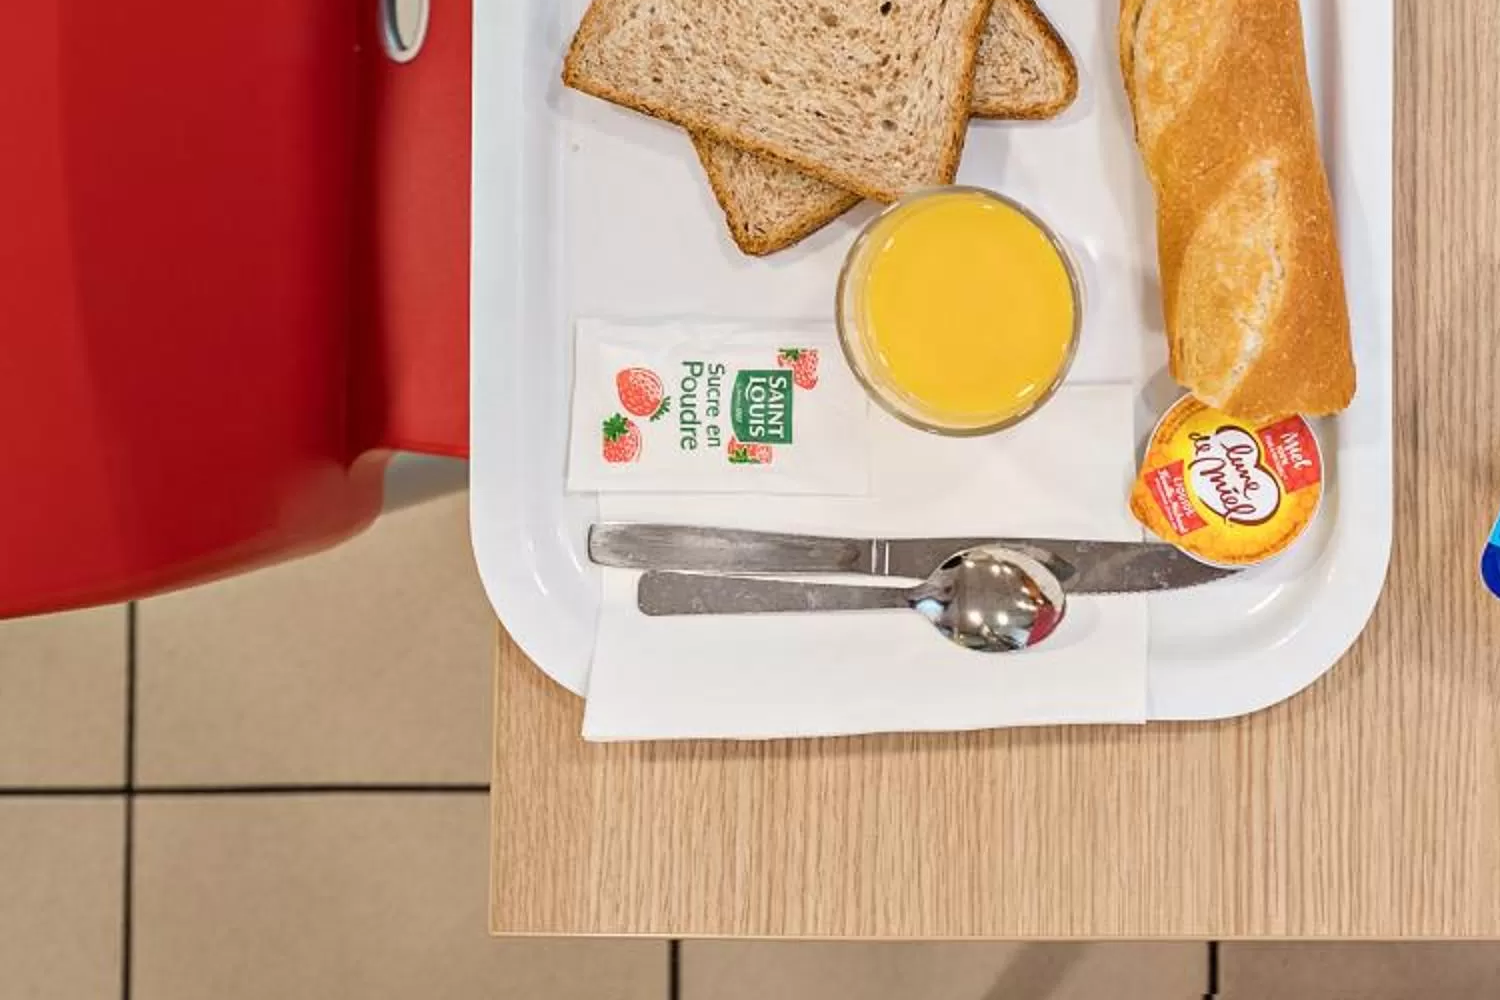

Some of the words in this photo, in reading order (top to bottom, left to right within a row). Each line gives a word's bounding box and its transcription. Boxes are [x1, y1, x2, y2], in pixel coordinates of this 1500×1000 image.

[679, 361, 704, 451] Poudre
[705, 363, 725, 418] Sucre
[745, 377, 768, 438] LOUIS
[768, 376, 788, 439] SAINT
[707, 419, 721, 448] en
